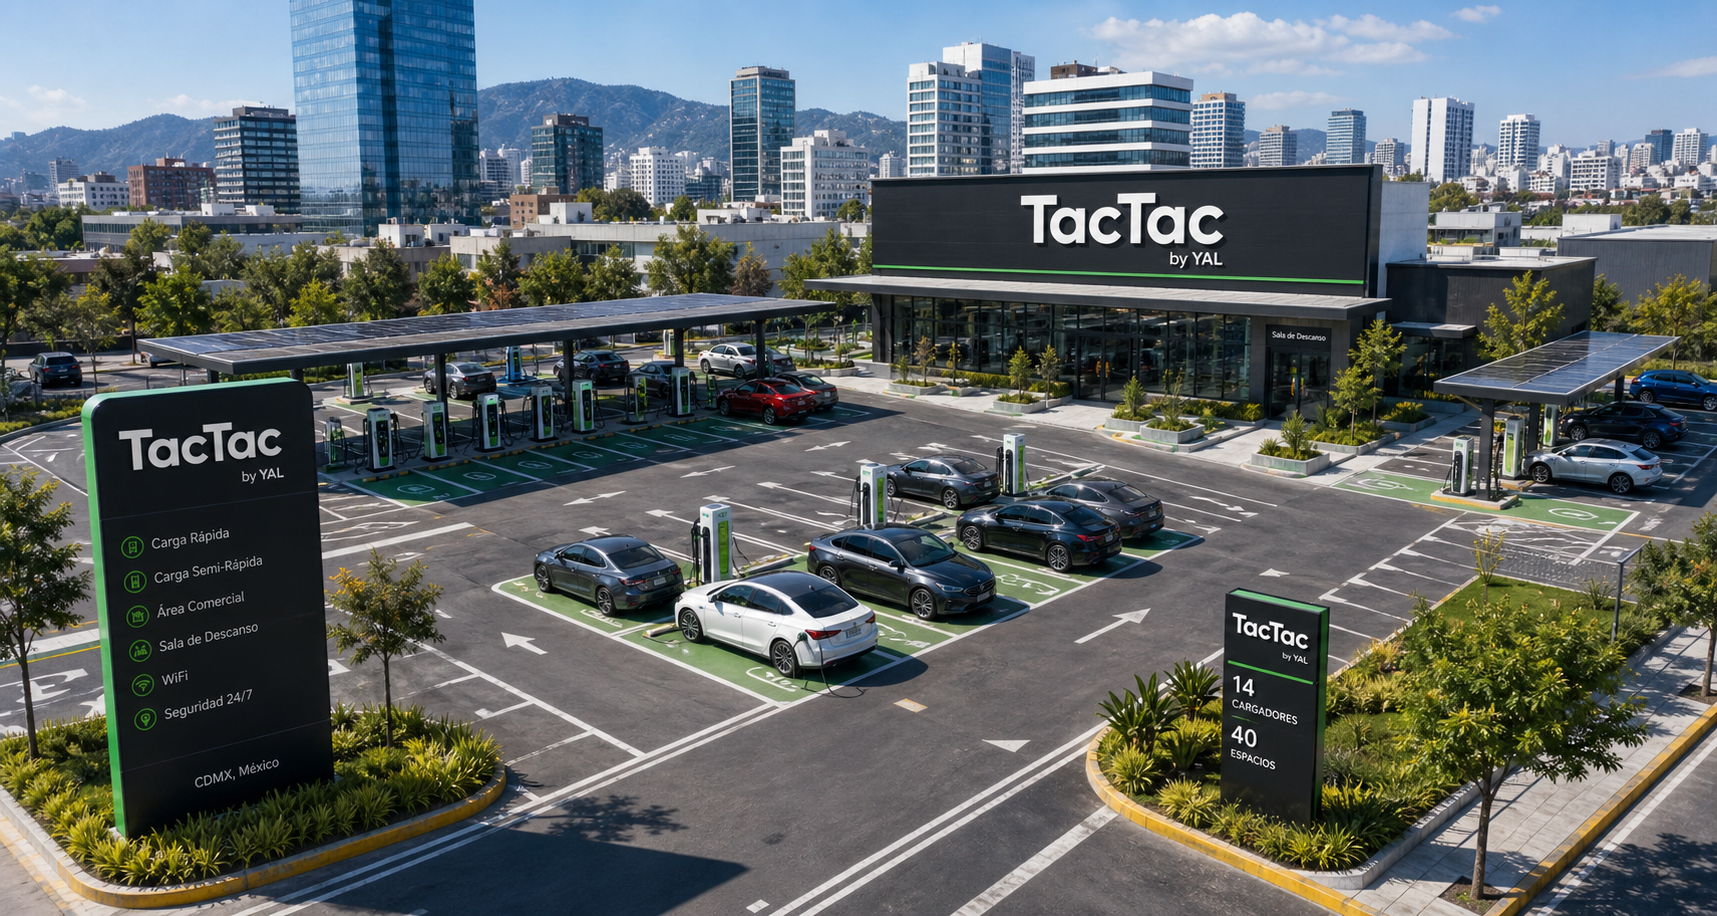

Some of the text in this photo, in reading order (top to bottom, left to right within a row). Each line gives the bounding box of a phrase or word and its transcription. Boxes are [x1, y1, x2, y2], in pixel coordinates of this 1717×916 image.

[1020, 192, 1224, 245] TacTac
[1169, 252, 1223, 268] by YAL
[1272, 331, 1286, 339] Sala
[1296, 333, 1327, 342] Descanso
[118, 422, 283, 471] TacTac
[241, 468, 284, 484] by YAL
[151, 528, 230, 550] Carga Rápida
[154, 556, 263, 584] Carga Semi-Rápida
[156, 591, 245, 618] Área Comercial
[159, 623, 259, 652] Sala de Descanso
[1232, 612, 1309, 650] TacTac
[1282, 652, 1308, 665] by YAL
[161, 670, 189, 686] WiFi
[1232, 675, 1255, 697] 14
[164, 689, 253, 720] Seguridad 24/7
[1231, 699, 1298, 725] CARGADORES
[1230, 725, 1258, 748] 40
[1230, 749, 1276, 770] ESPACIOS
[194, 758, 280, 789] CDMX, México
